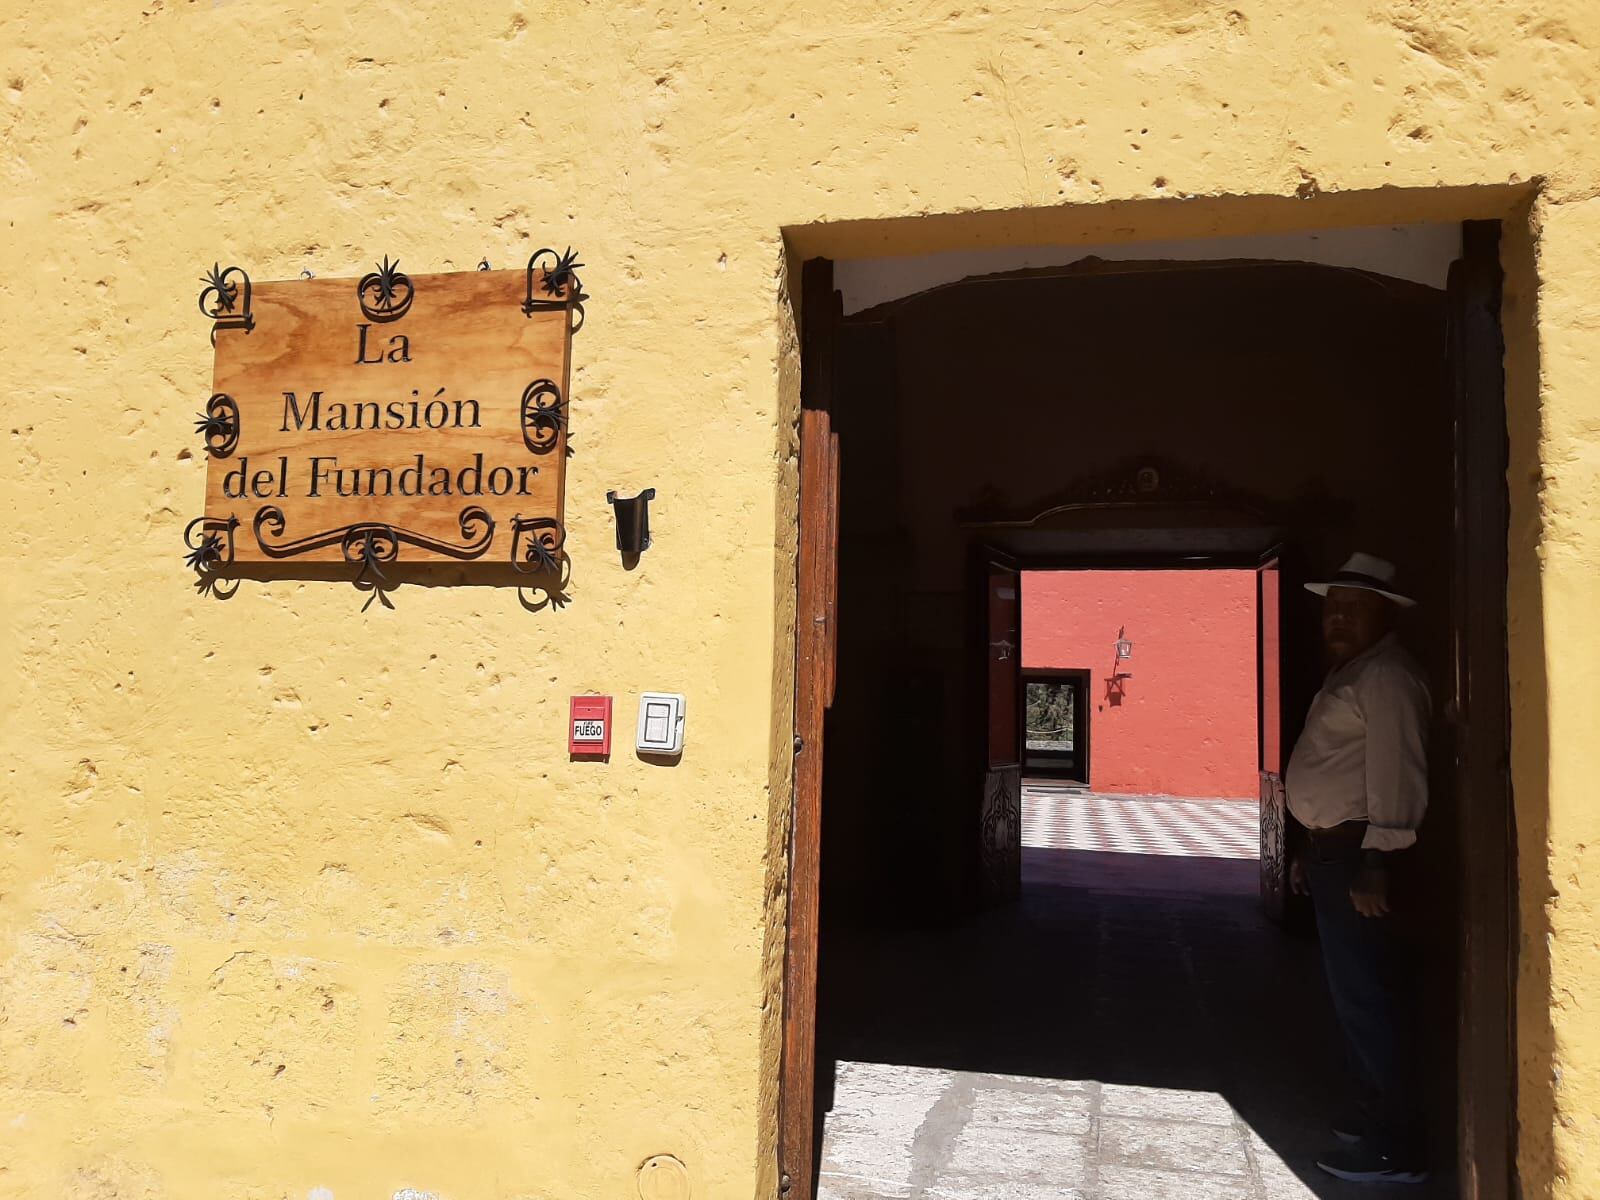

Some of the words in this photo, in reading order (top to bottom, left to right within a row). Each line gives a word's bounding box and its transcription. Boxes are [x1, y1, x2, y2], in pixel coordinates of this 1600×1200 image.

[355, 323, 412, 364] La
[279, 387, 482, 432] Mansión
[222, 456, 289, 498] del
[305, 452, 540, 498] Fundador
[574, 725, 602, 736] FUEGO
